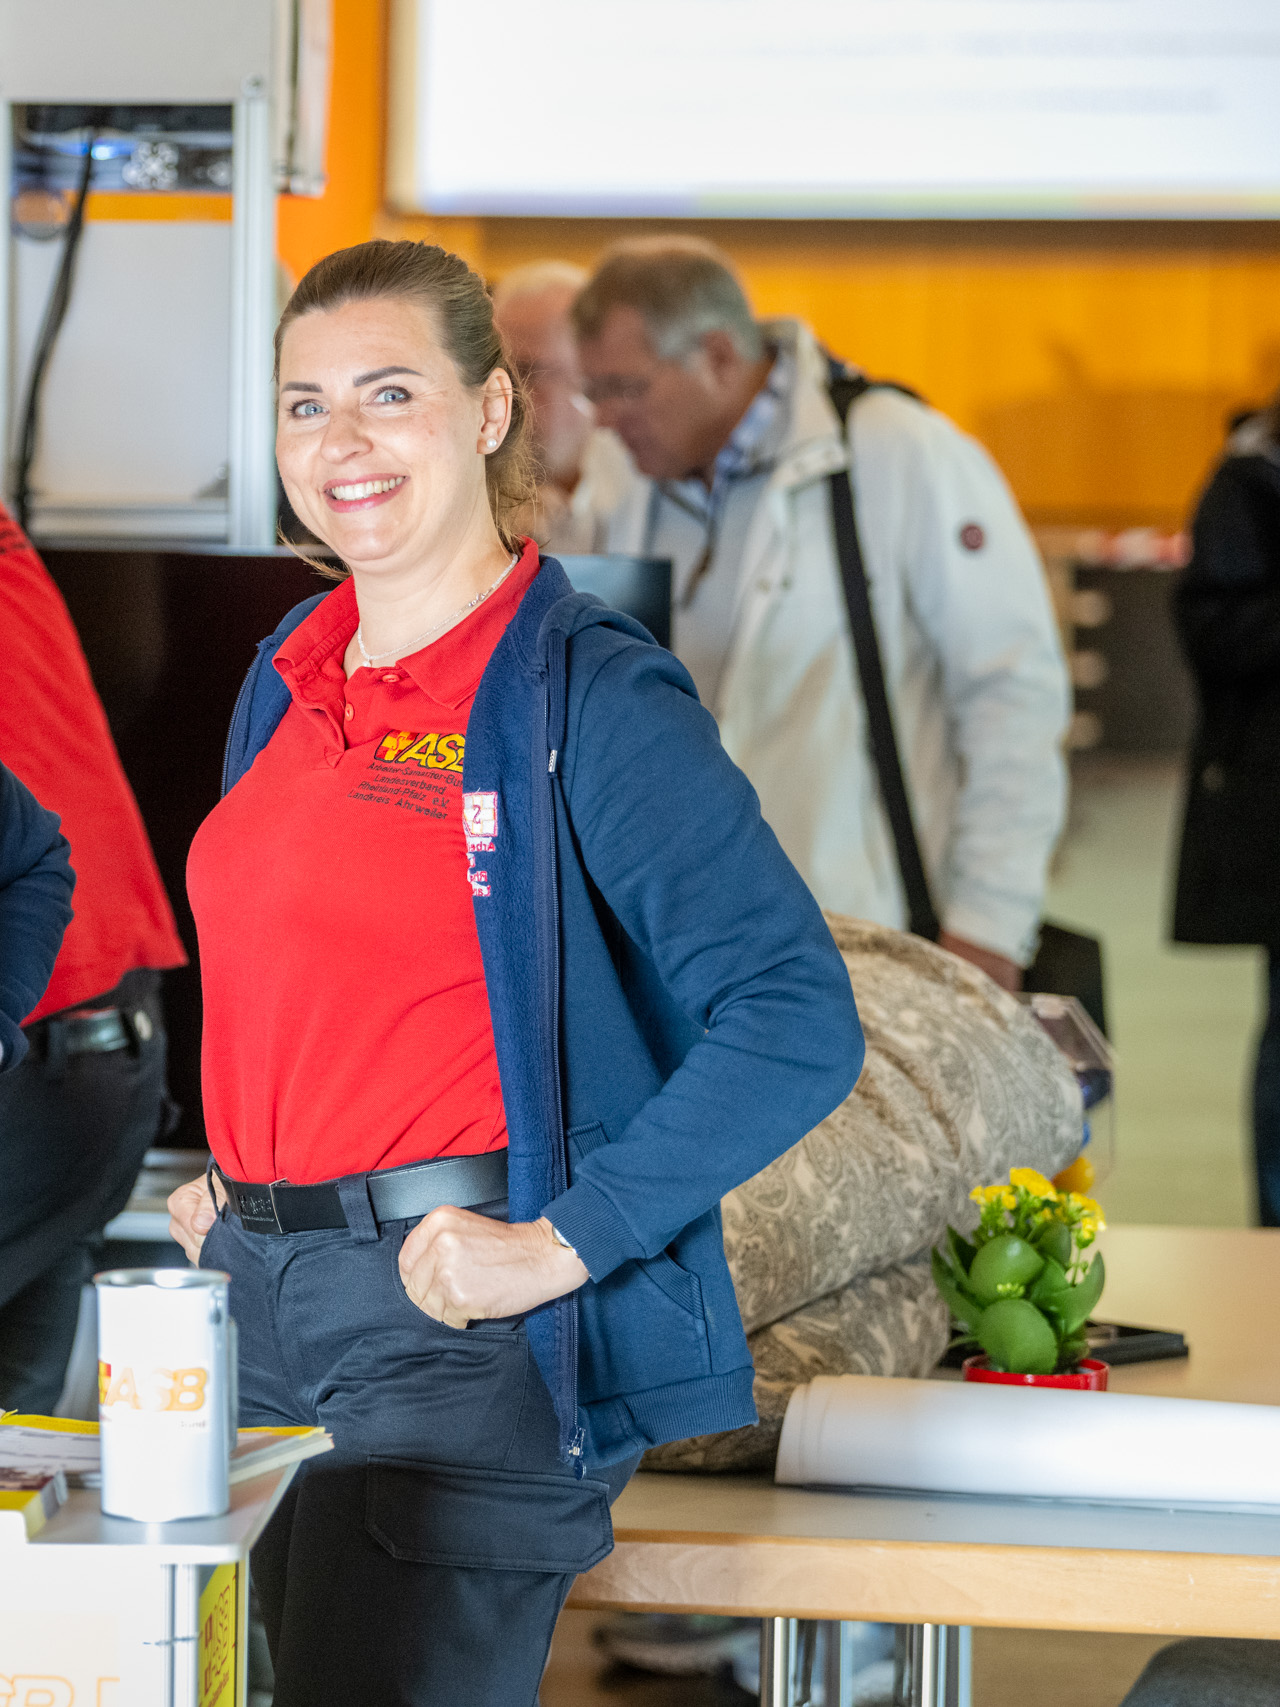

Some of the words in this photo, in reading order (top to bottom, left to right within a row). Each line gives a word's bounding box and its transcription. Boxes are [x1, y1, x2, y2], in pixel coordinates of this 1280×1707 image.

[358, 780, 427, 802] Rheinland-Pfalz
[373, 773, 447, 795] Landesverband
[347, 789, 391, 805] Landkreis
[394, 797, 448, 820] Ahrweiler
